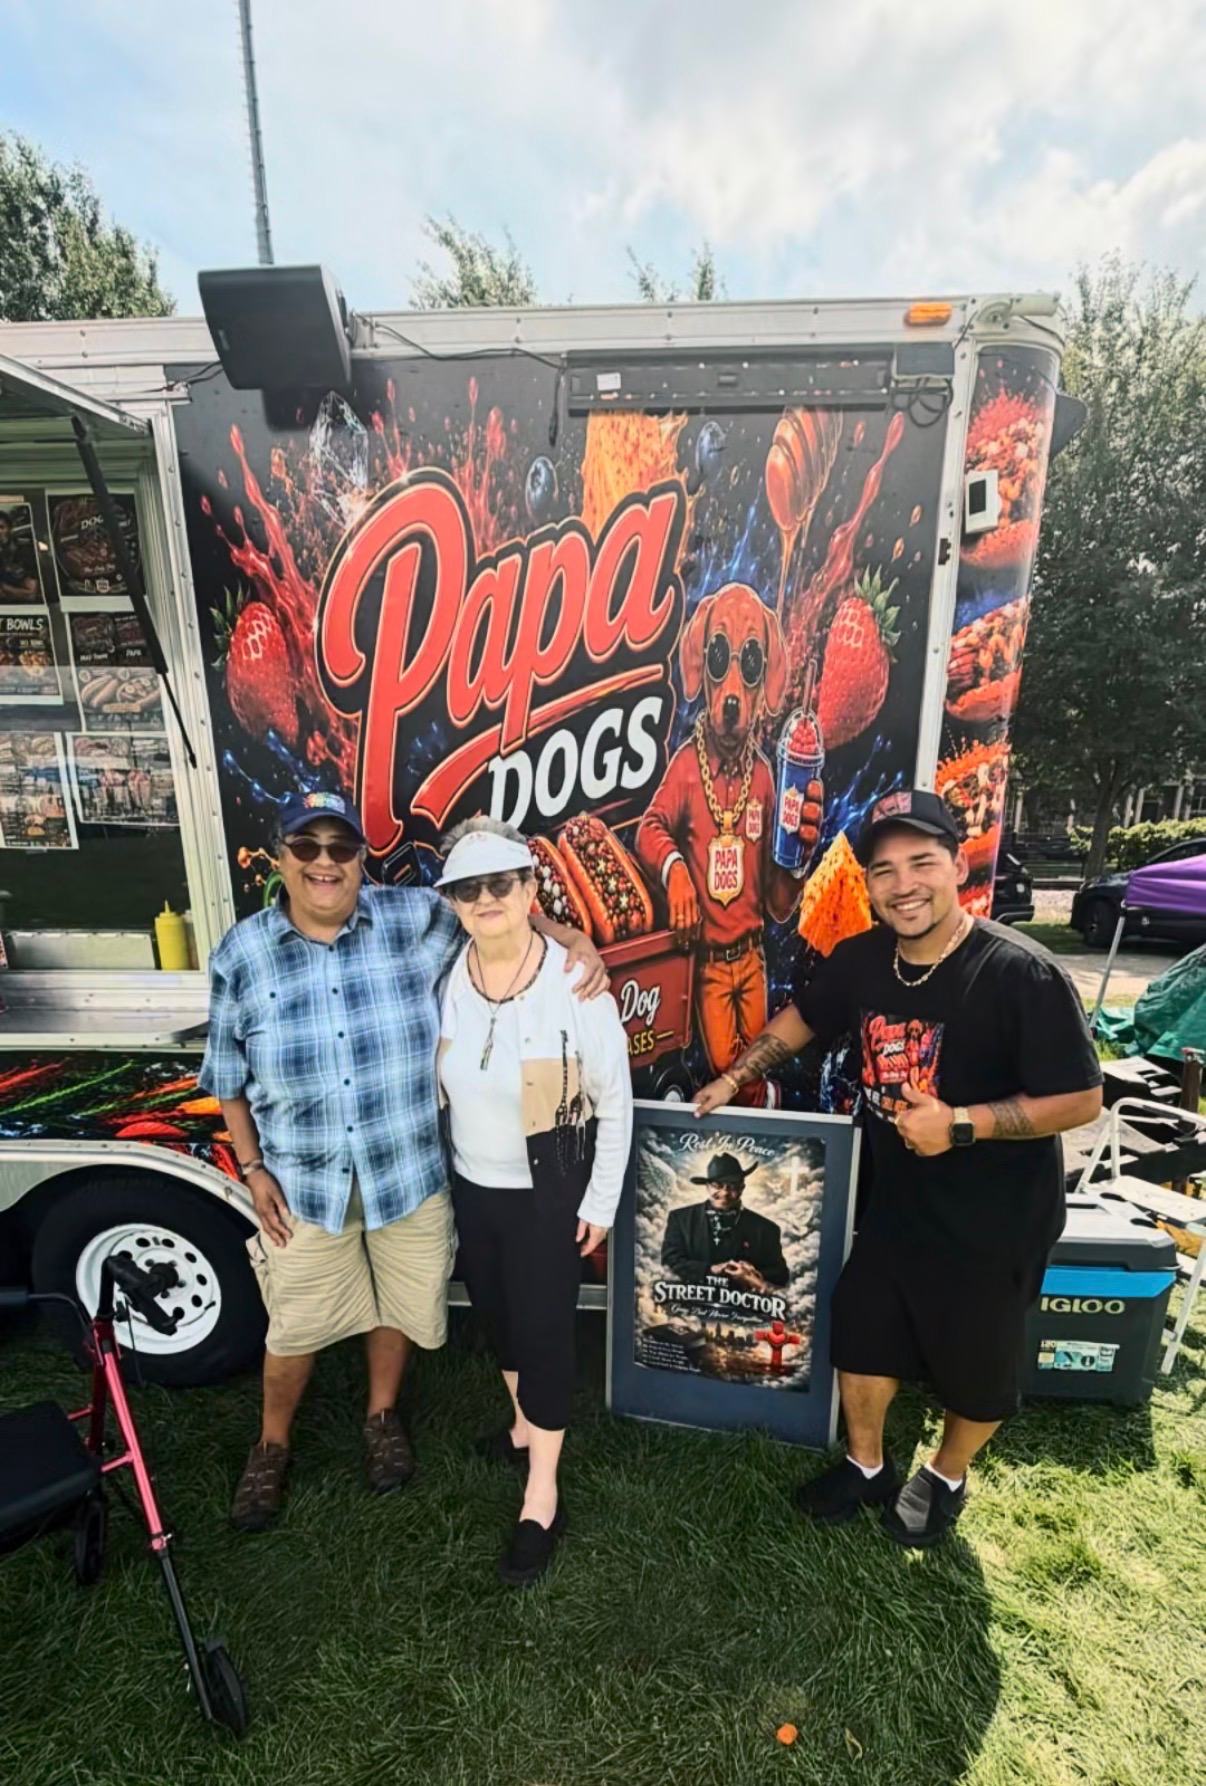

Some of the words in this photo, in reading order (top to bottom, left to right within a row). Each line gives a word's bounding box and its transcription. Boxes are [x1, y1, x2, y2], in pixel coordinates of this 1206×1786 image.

[6, 618, 44, 631] BOWLS
[322, 482, 678, 855] Papa
[488, 696, 663, 833] DOGS
[783, 796, 800, 810] PAPA
[715, 848, 738, 868] PAPA
[714, 870, 738, 891] DOGS
[621, 979, 661, 1026] Dog
[679, 1132, 712, 1152] Rest
[713, 1135, 733, 1151] In
[737, 1136, 776, 1156] Peace
[706, 1275, 729, 1287] THE
[654, 1281, 716, 1303] STREET
[720, 1288, 786, 1320] DOCTOR
[1041, 1297, 1125, 1314] IGLOO
